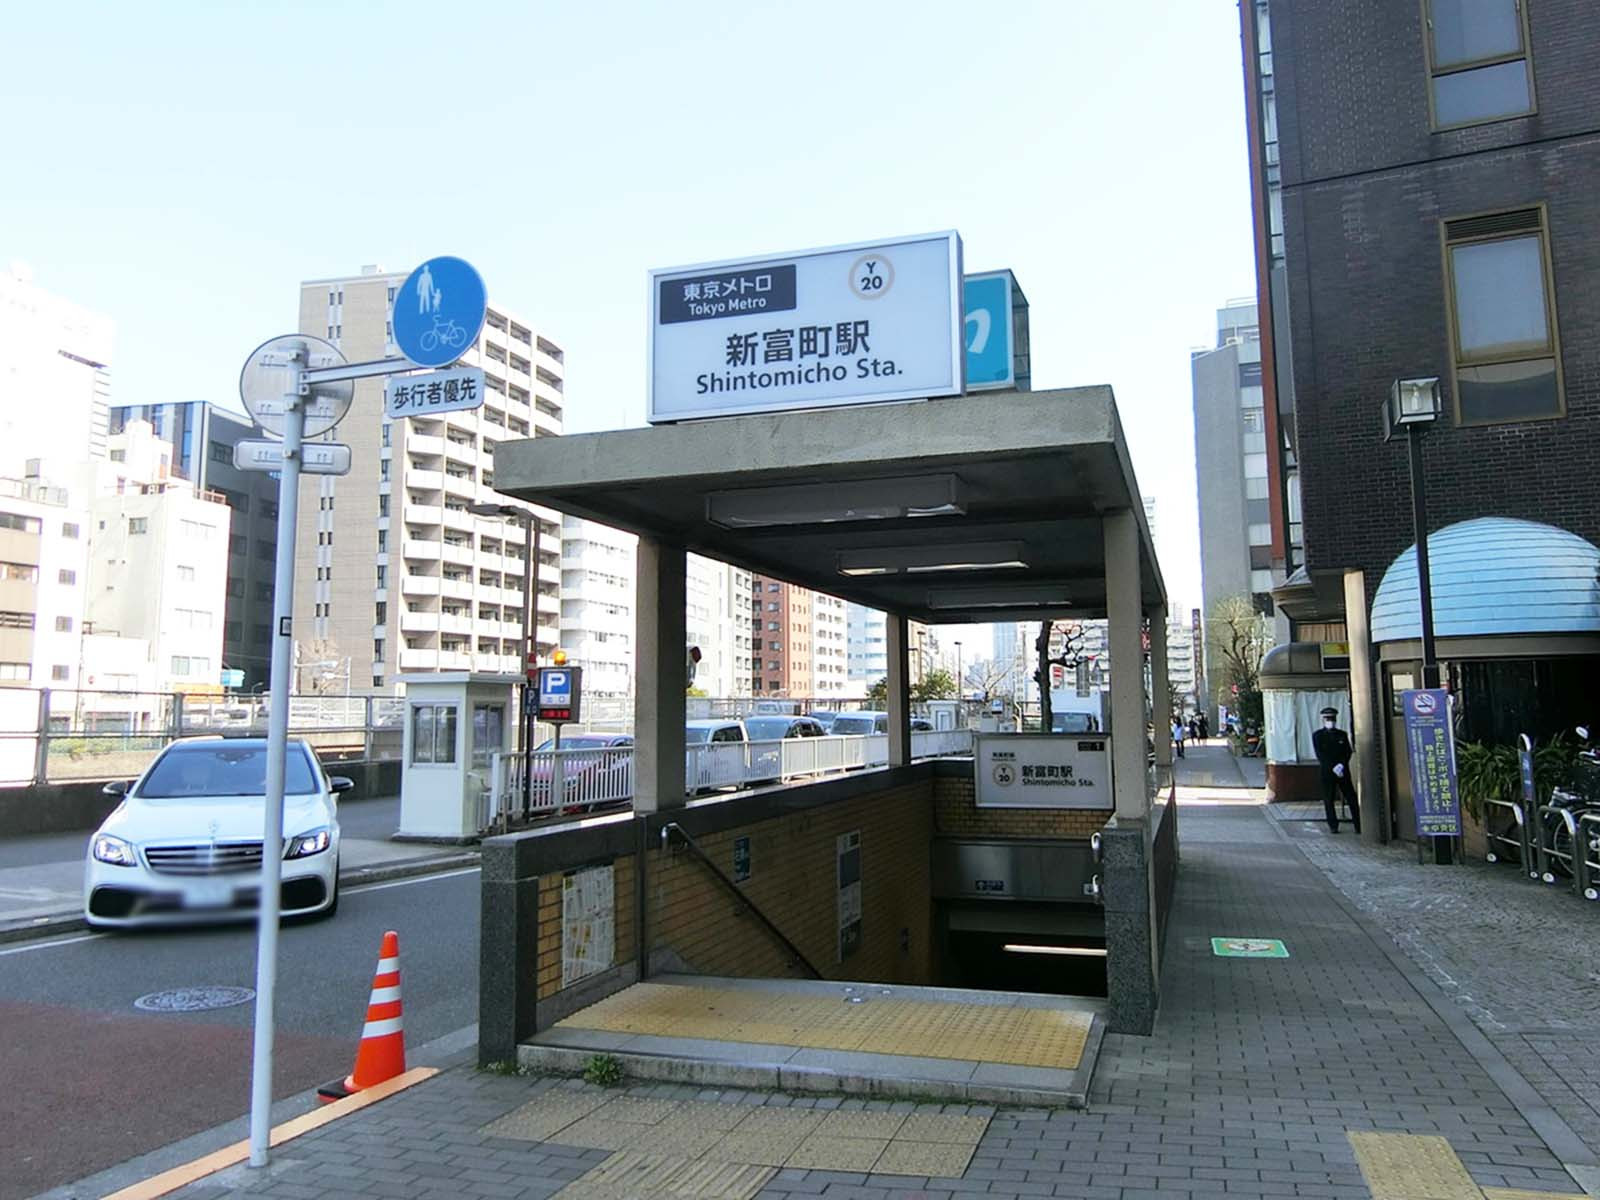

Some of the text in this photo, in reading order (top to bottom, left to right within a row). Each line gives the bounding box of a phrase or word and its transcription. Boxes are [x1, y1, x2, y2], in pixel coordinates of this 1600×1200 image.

[867, 262, 876, 274] Y
[684, 274, 772, 301] 東京メトロ
[861, 275, 883, 291] 20
[689, 297, 766, 318] Tokyo Metro
[727, 320, 870, 368] 新富町駅
[697, 357, 903, 395] Shintomicho Sta.
[394, 377, 477, 410] 歩行者優先
[546, 672, 566, 693] P
[999, 774, 1010, 783] 20
[1022, 766, 1073, 778] 新富町駅
[1022, 778, 1095, 788] Shintomicho Sta.
